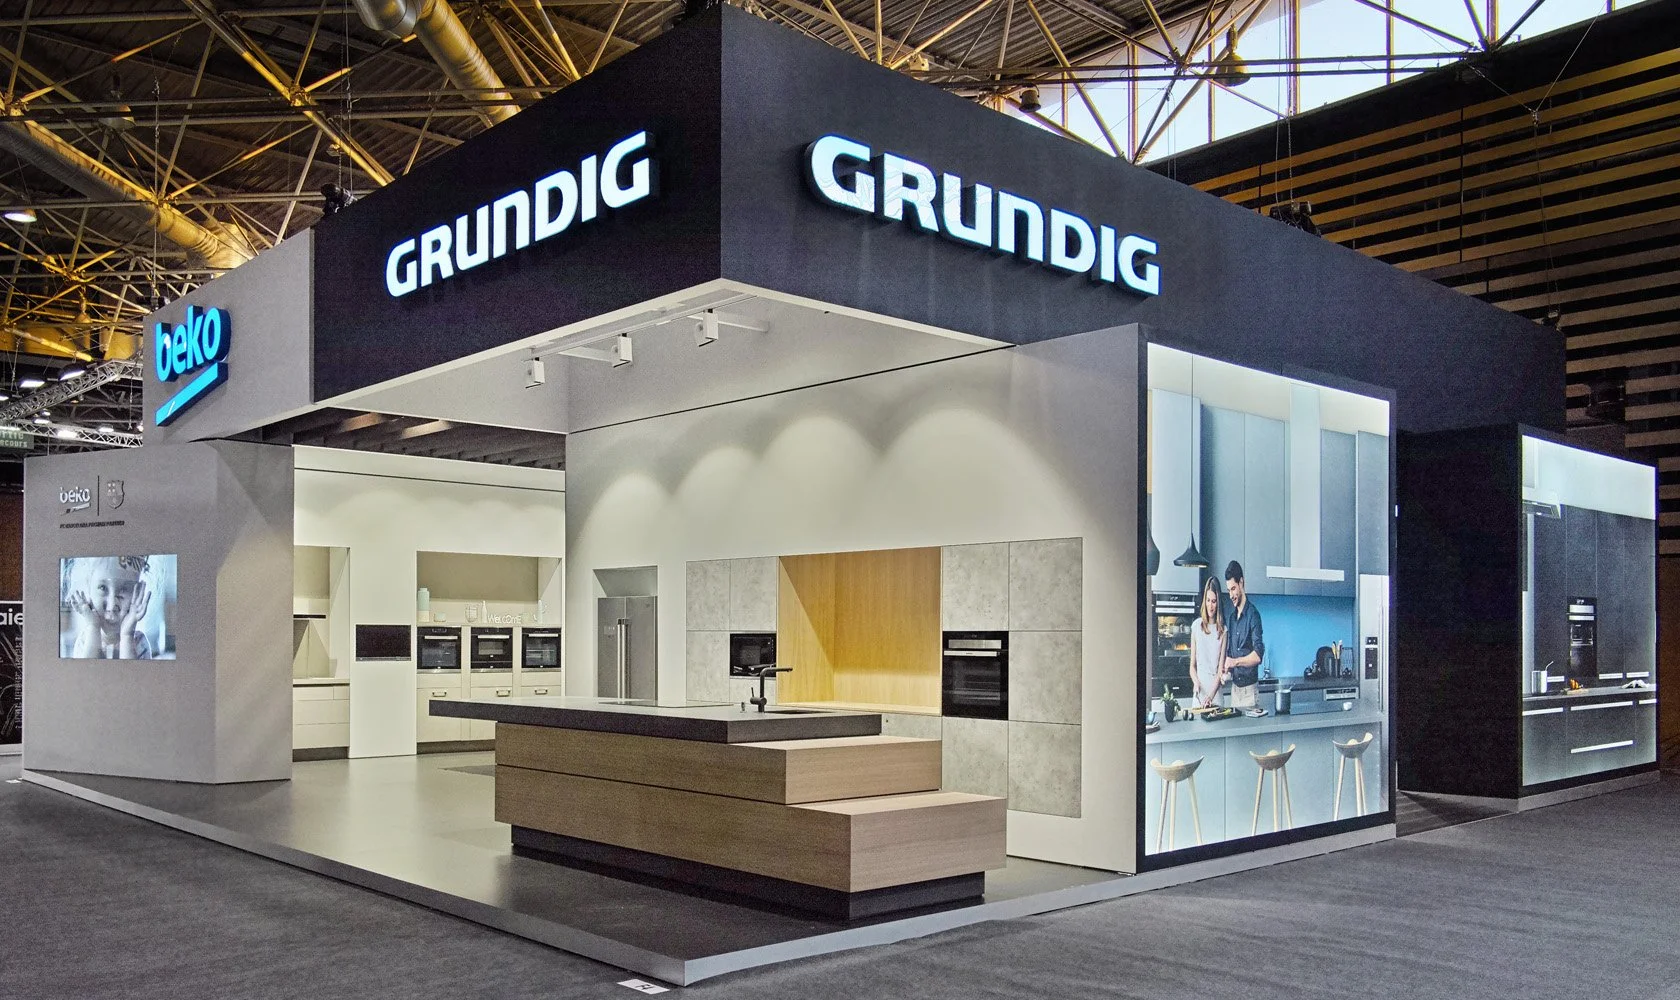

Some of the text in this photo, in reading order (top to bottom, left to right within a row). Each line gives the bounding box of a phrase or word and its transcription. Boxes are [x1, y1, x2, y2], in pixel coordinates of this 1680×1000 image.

[386, 130, 651, 298] GRUNDIG
[810, 134, 1161, 296] GRUNDIG
[155, 304, 222, 382] beko
[59, 485, 91, 503] beko
